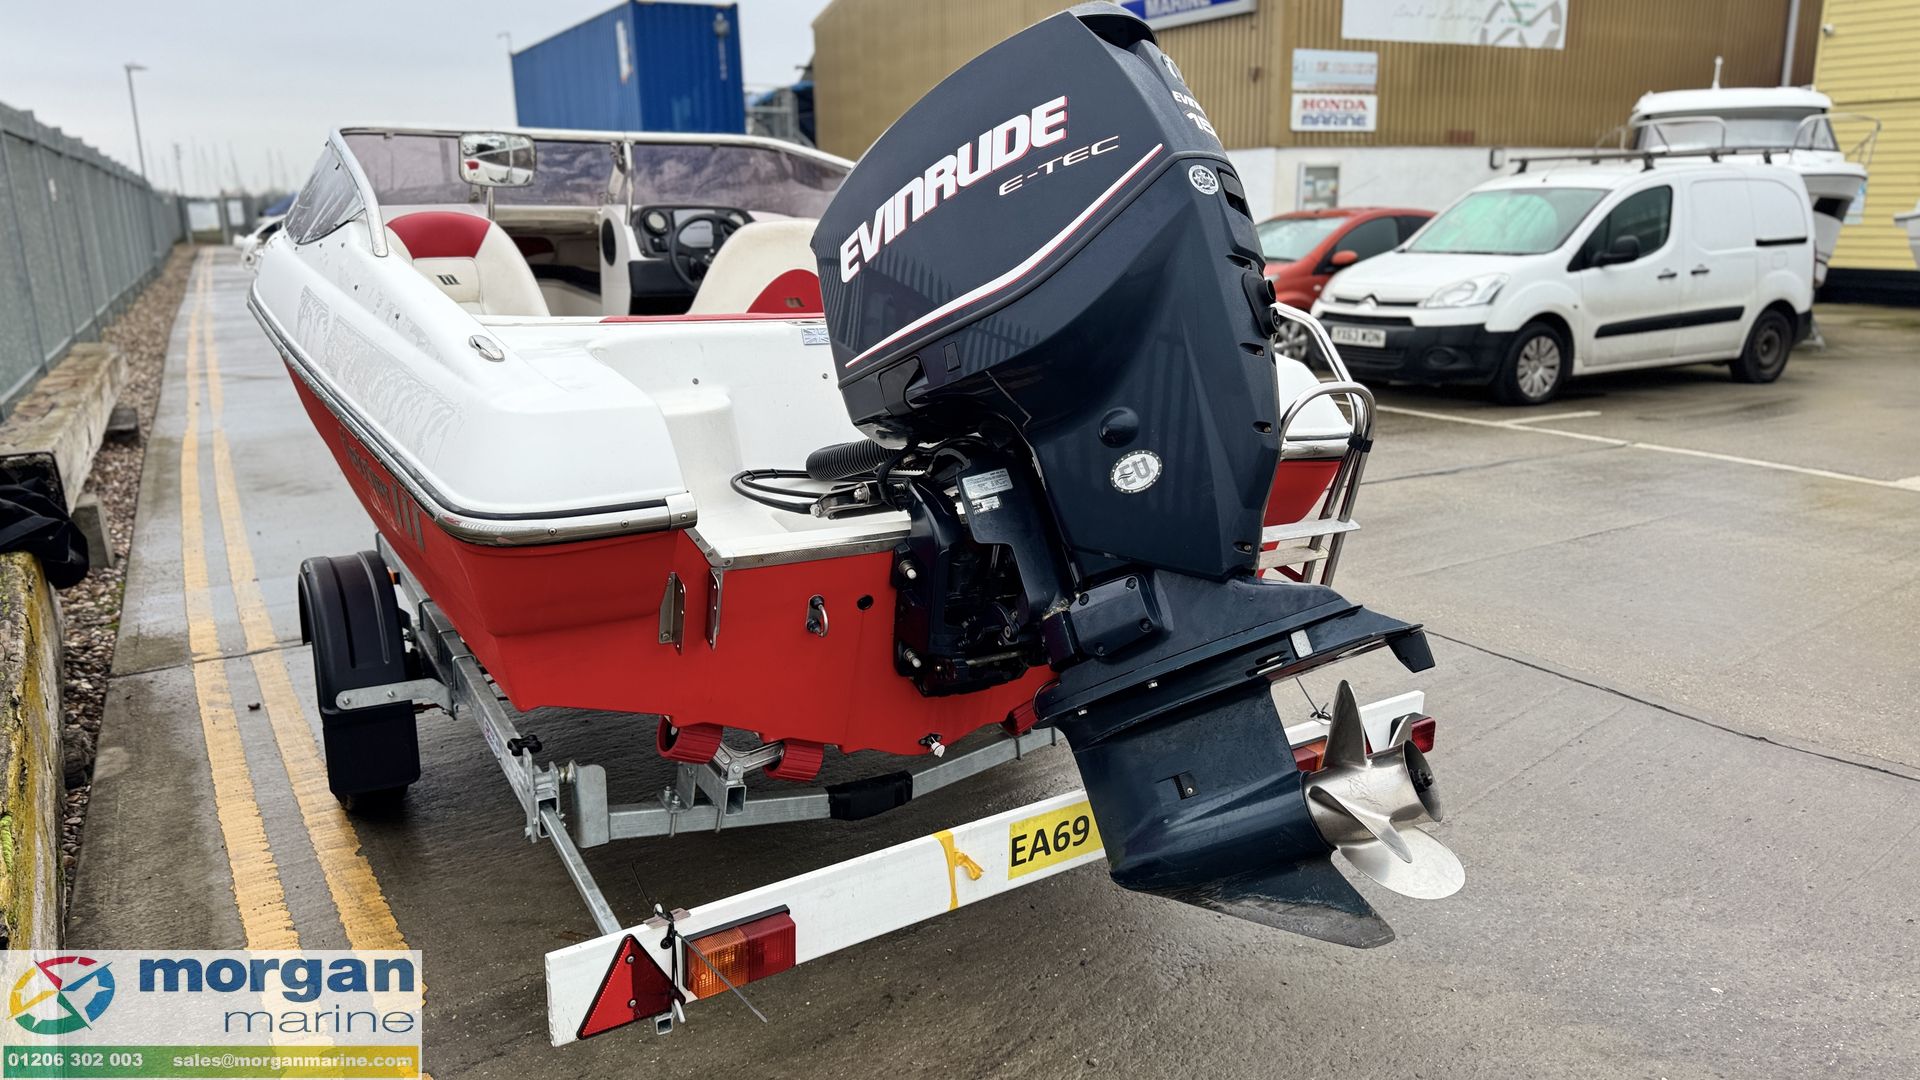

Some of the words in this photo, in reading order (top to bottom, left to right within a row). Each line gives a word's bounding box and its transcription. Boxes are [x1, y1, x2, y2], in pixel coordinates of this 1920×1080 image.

[1301, 98, 1367, 111] HONDA
[1301, 112, 1366, 127] MARINE
[839, 95, 1068, 284] EVINRUDE
[999, 135, 1120, 197] E-TEC
[1010, 815, 1090, 867] EA69
